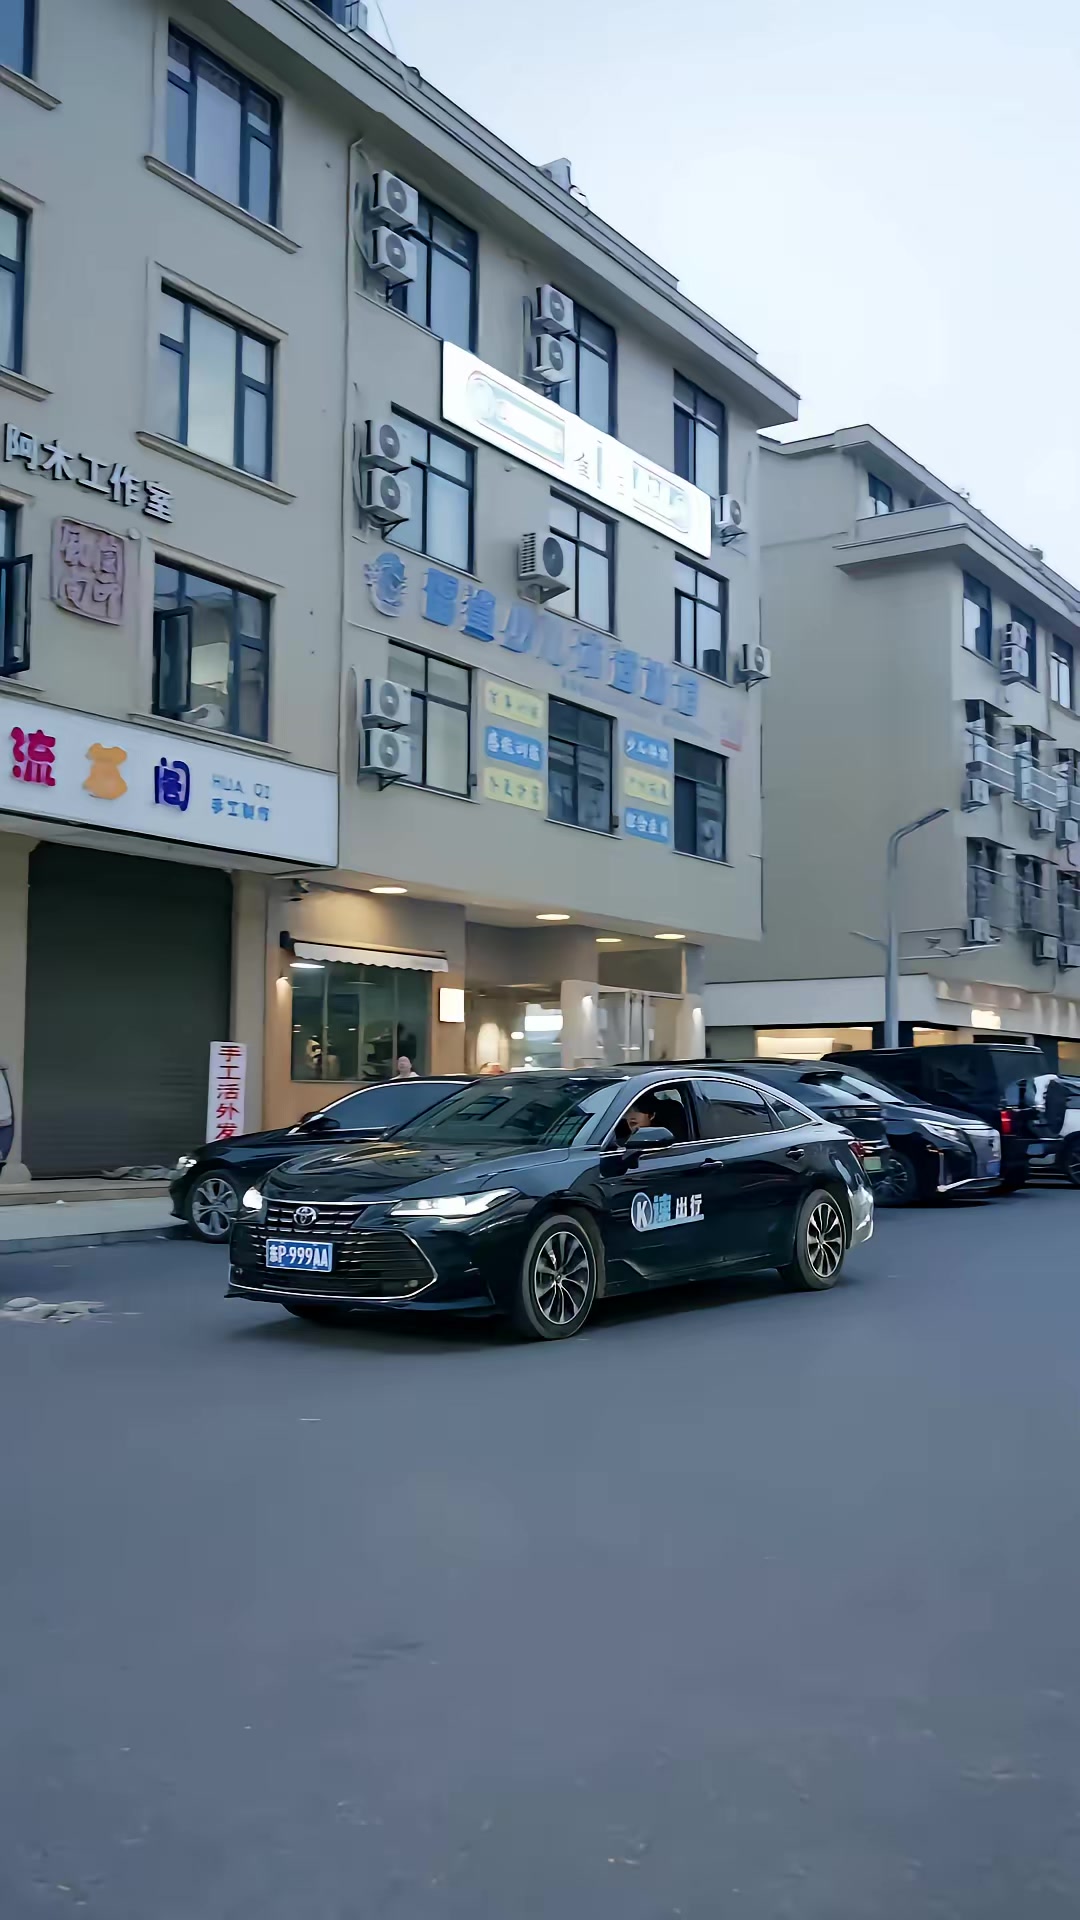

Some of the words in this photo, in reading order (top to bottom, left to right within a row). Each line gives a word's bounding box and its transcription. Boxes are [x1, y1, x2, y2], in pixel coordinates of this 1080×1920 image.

[4, 422, 173, 523] 阿木工作室
[215, 1045, 242, 1139] 手工活外发
